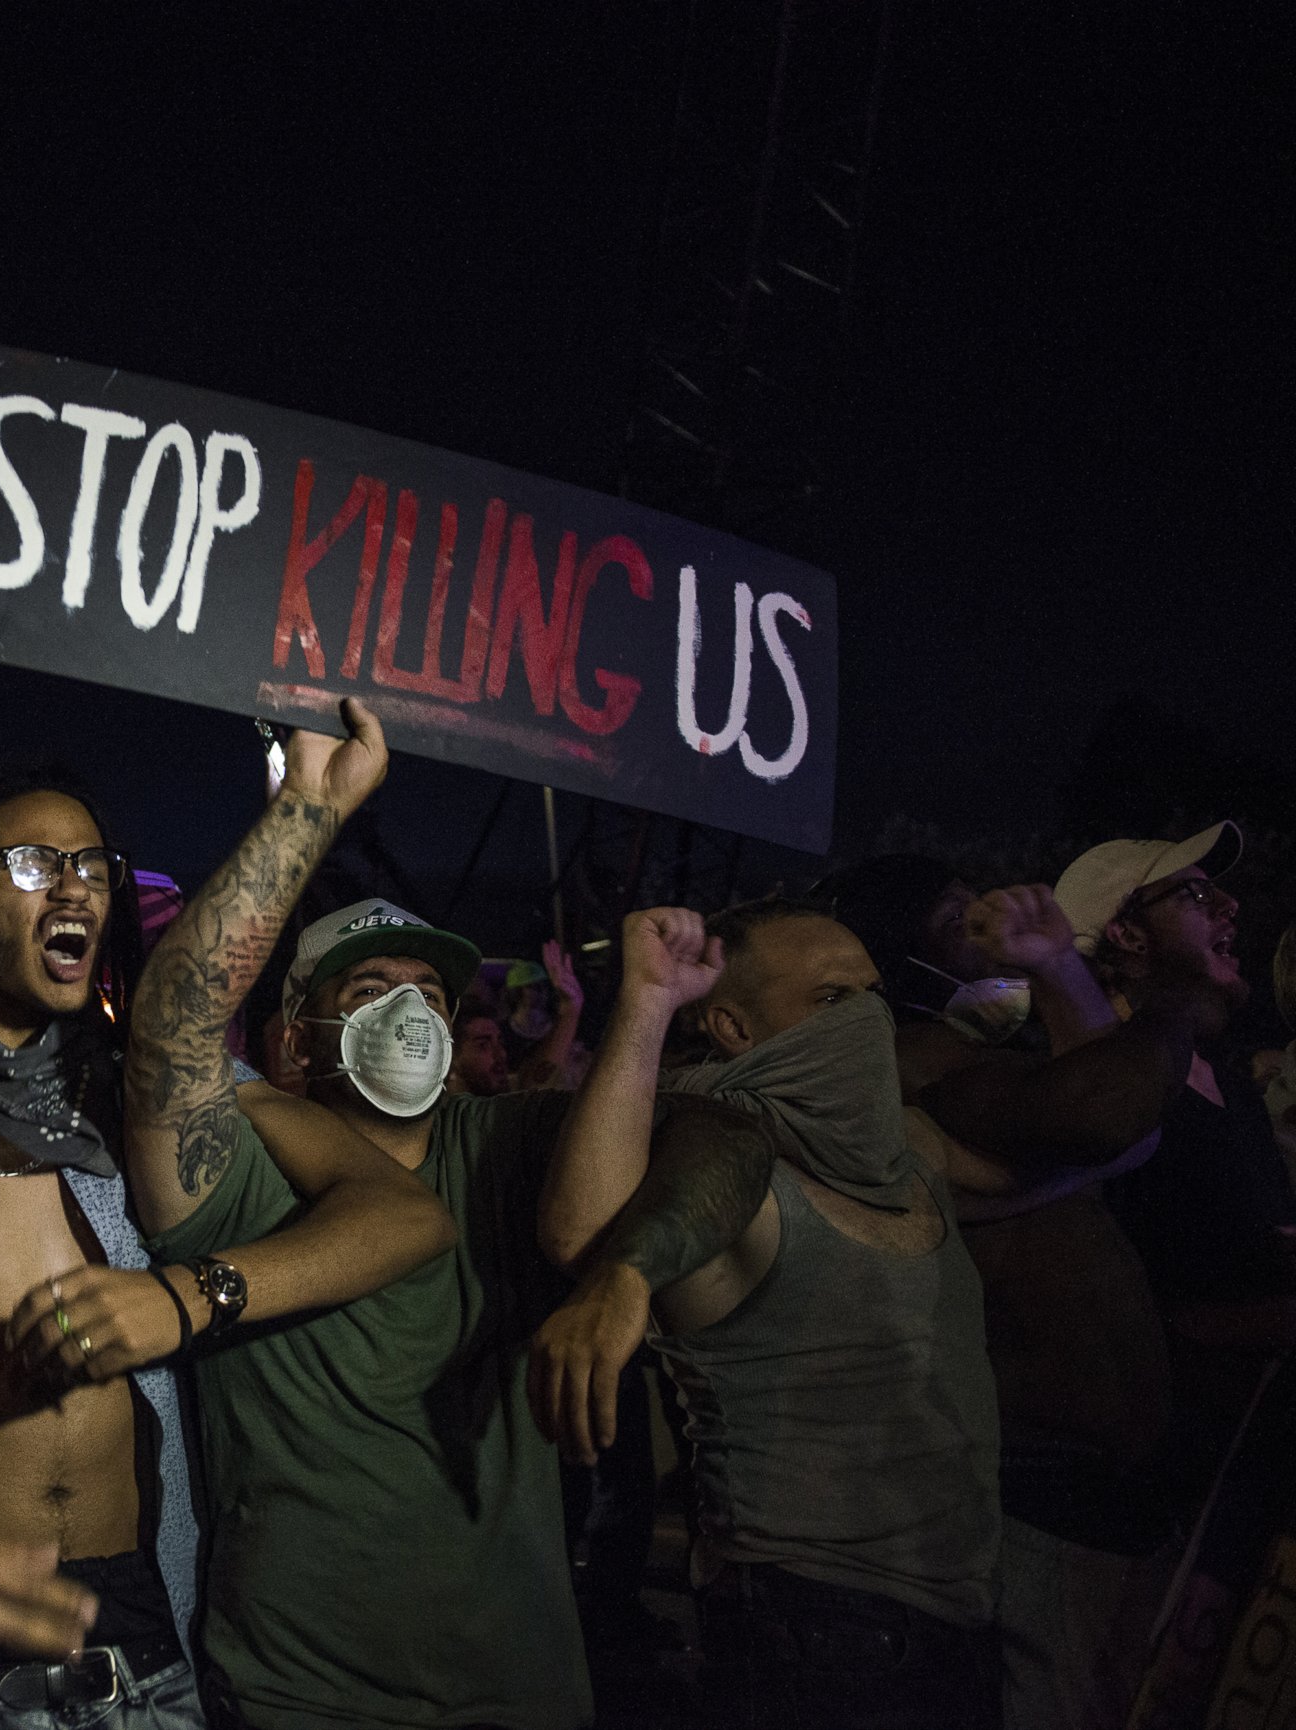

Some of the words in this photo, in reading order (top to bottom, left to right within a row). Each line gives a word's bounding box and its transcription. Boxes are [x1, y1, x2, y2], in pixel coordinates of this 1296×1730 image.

[271, 457, 654, 738] KILLING
[676, 564, 813, 782] US
[350, 915, 405, 931] JETS
